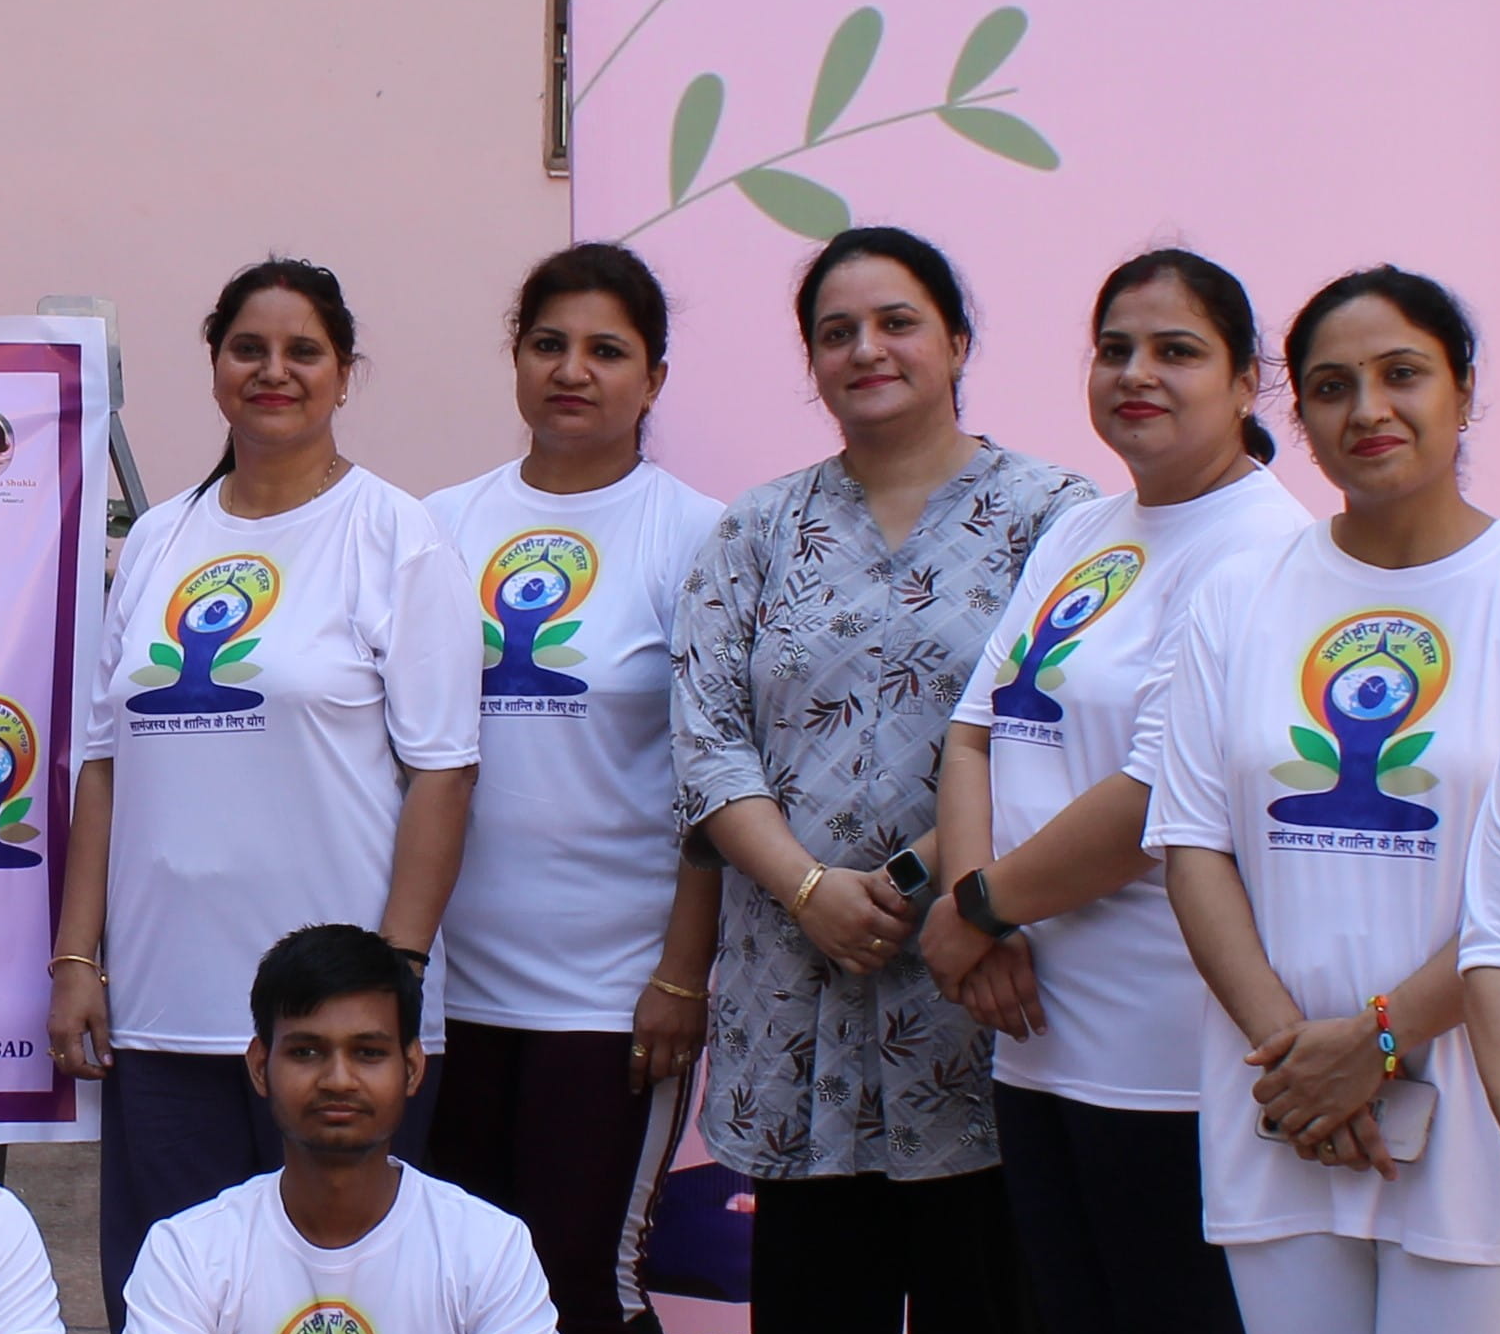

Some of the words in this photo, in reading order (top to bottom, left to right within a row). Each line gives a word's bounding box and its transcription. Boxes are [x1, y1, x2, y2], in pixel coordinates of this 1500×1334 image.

[6, 479, 37, 487] Shukla
[549, 537, 572, 550] योग
[1385, 619, 1416, 638] योग
[1414, 631, 1437, 665] दिवस
[504, 699, 533, 712] शान्ति
[535, 700, 544, 712] के
[547, 699, 567, 713] लिए
[569, 699, 587, 714] योग
[11, 716, 22, 727] of
[168, 717, 181, 732] एवं
[213, 716, 223, 729] के
[226, 714, 244, 729] लिए
[247, 713, 265, 728] योग
[1317, 831, 1333, 848] एवं
[1338, 832, 1373, 849] शान्ति
[1377, 834, 1390, 849] के
[1393, 835, 1414, 854] लिए
[1416, 837, 1436, 854] योग
